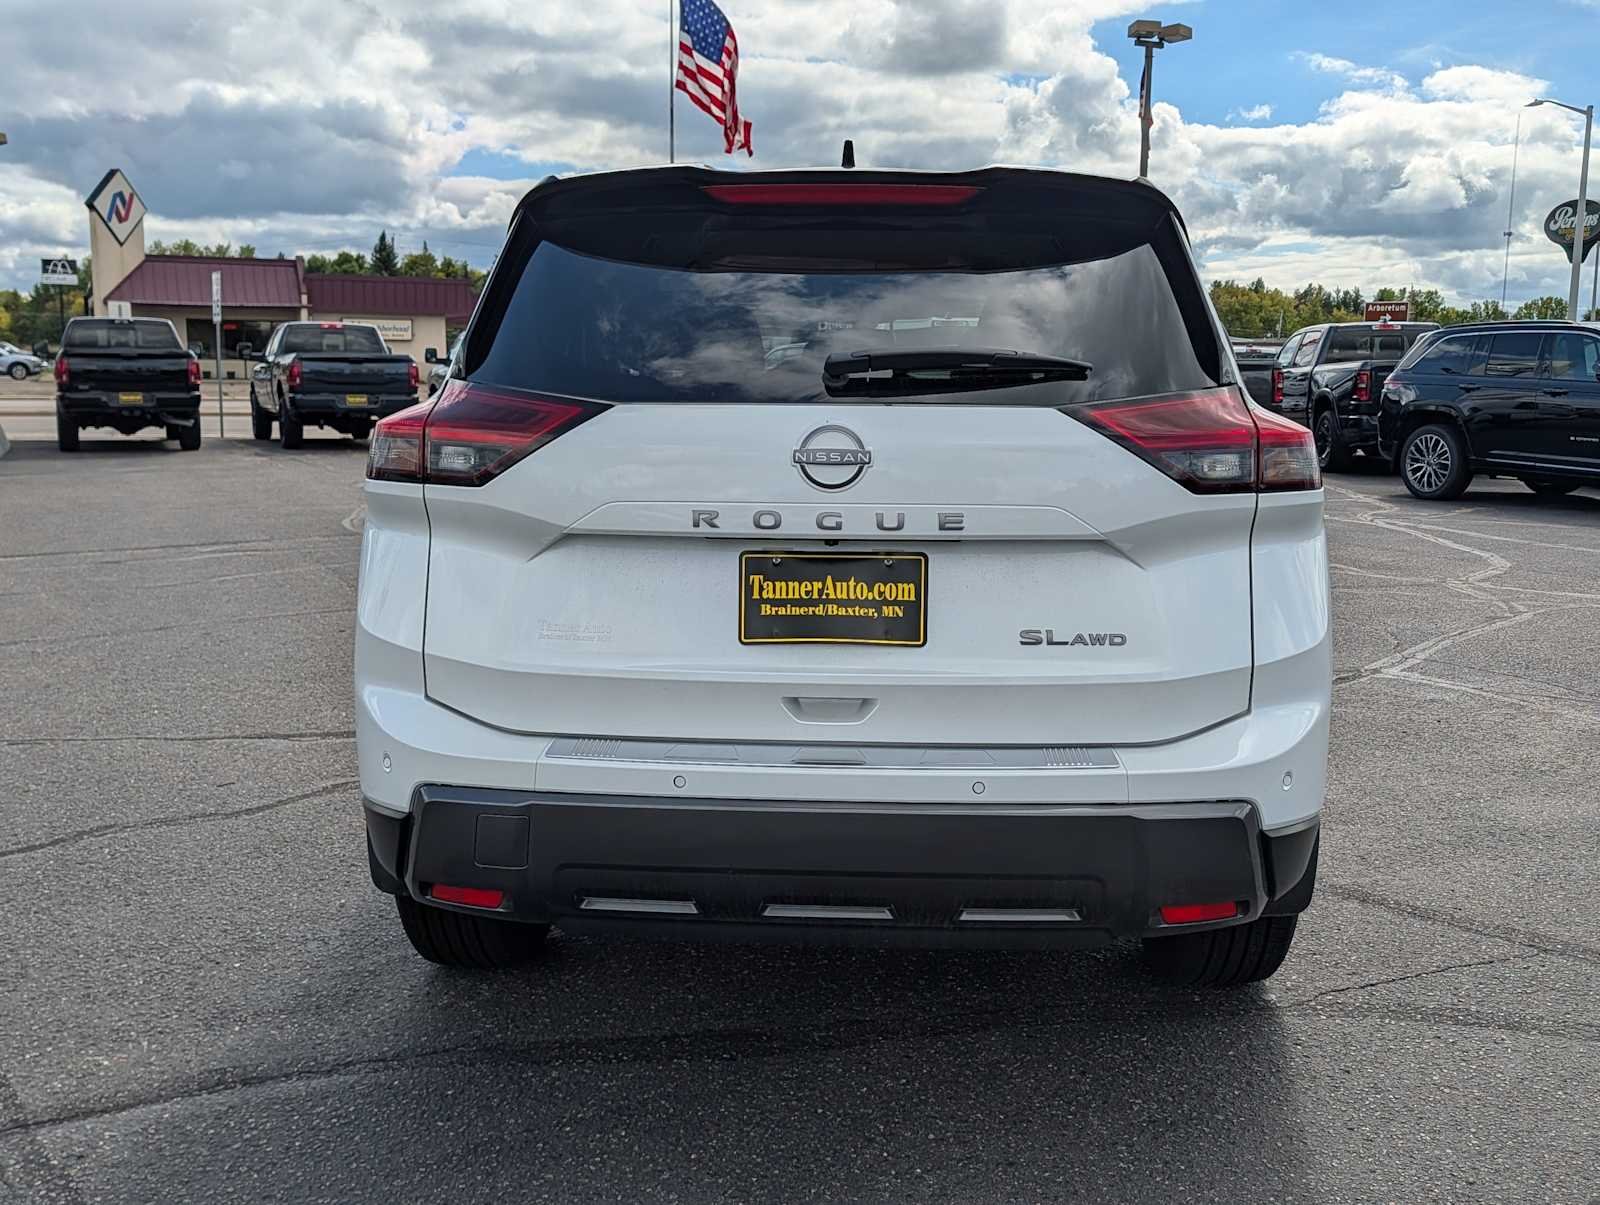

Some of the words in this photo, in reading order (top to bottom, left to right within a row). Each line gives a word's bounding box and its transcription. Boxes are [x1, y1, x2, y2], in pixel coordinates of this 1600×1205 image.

[1550, 206, 1599, 231] Perns
[1367, 304, 1407, 312] Arboretum
[795, 452, 871, 463] NISSAN
[691, 509, 966, 532] ROGUE
[750, 574, 917, 602] TannerAuto.com
[760, 603, 879, 619] Brainerd/Baxter,
[882, 605, 905, 618] MN
